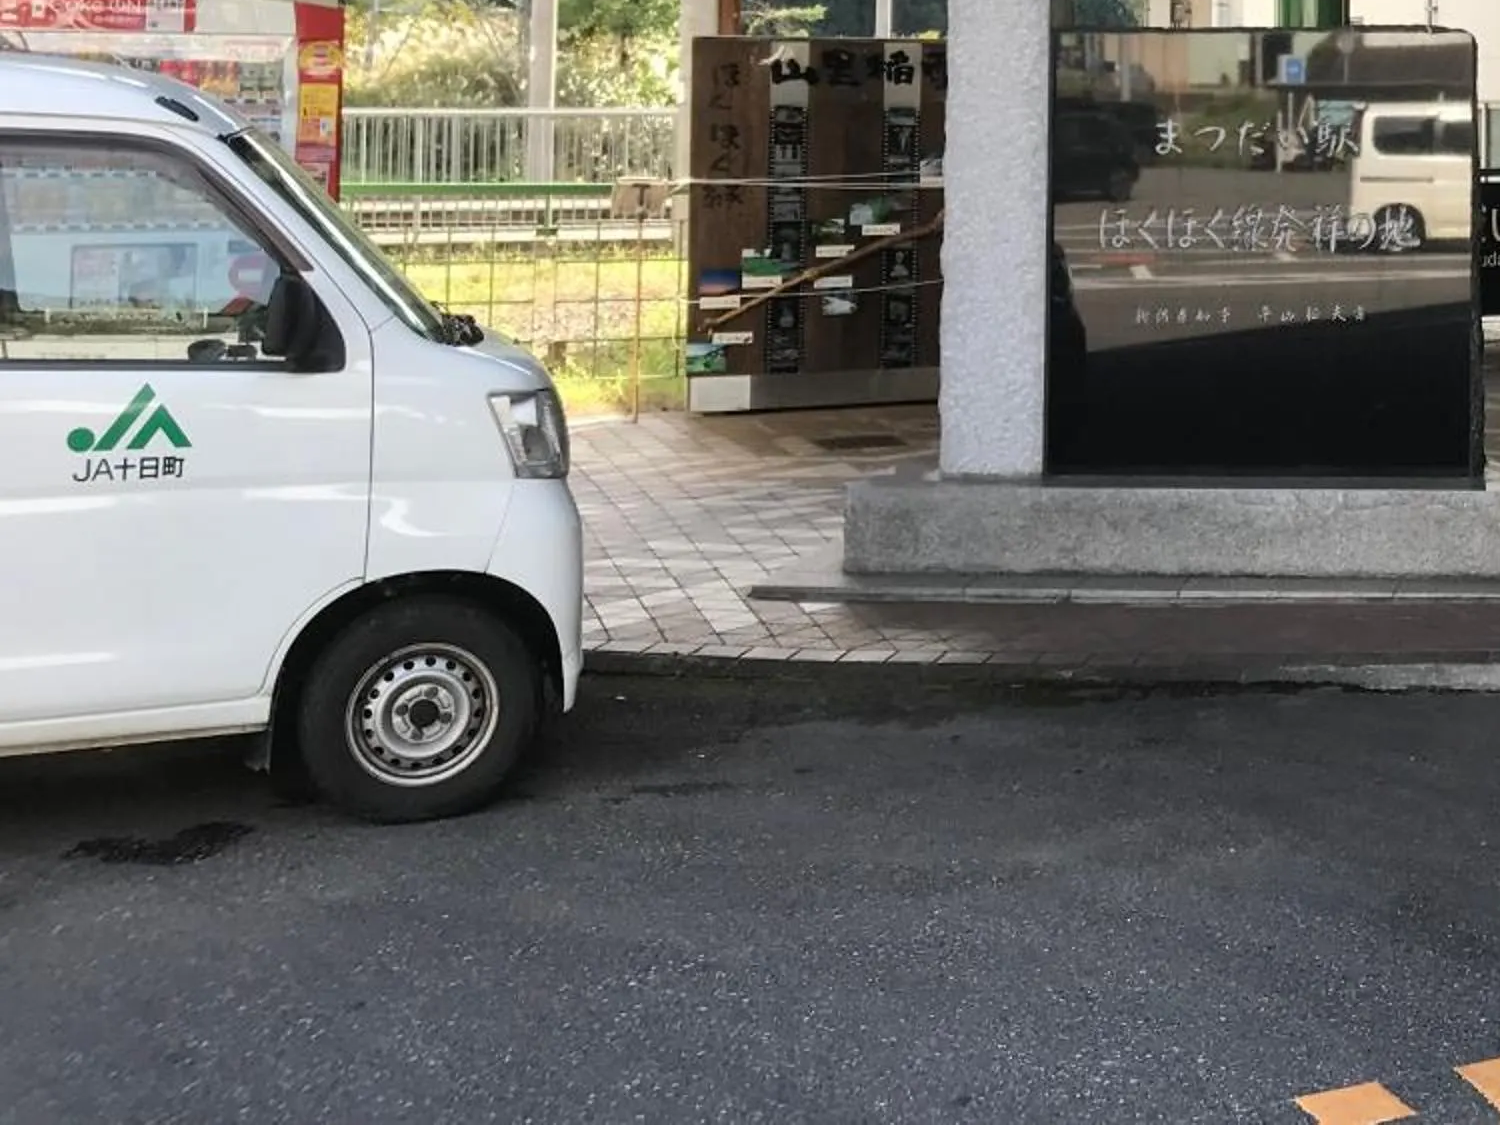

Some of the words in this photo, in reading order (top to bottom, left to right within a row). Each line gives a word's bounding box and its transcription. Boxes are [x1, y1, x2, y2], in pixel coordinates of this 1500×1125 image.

[1155, 118, 1360, 159] まつだい駅
[1100, 204, 1421, 252] ほくほく線発祥の地
[72, 456, 185, 482] JA十日町
